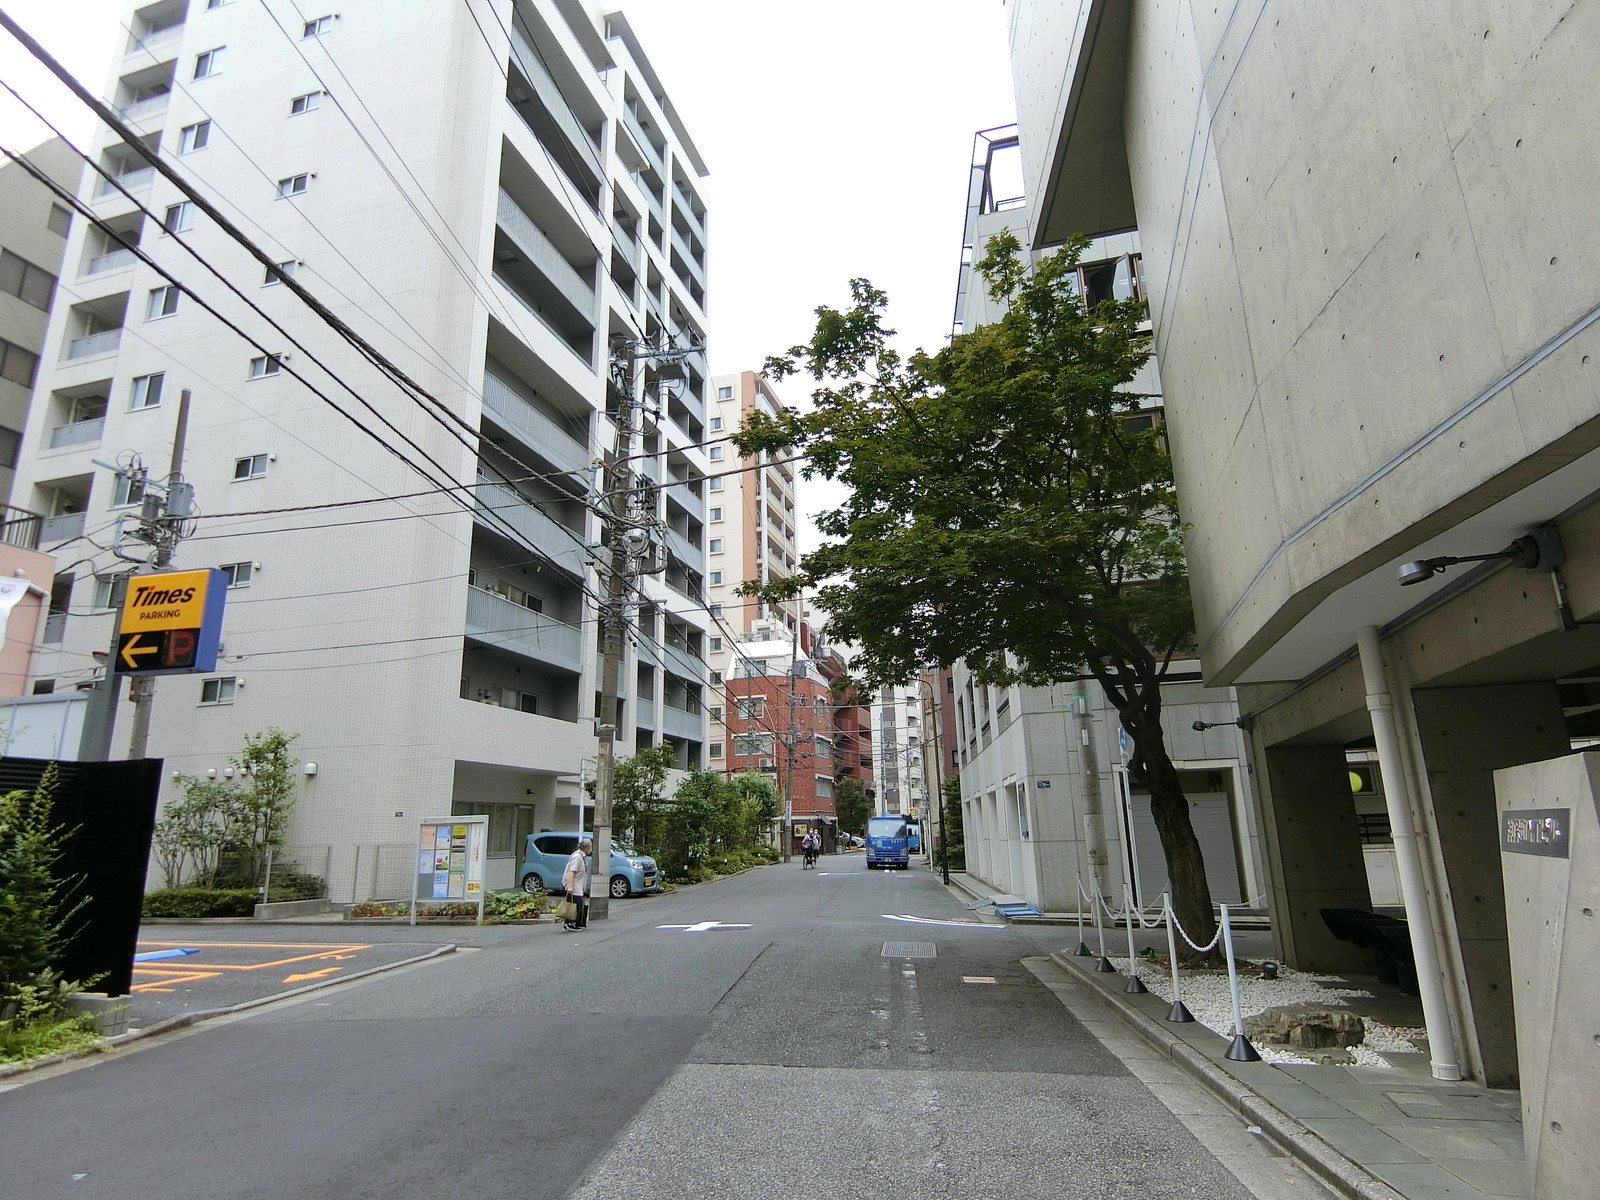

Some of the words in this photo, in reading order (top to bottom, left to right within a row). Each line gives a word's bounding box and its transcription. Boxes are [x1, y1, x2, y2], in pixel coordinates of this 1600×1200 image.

[132, 586, 196, 607] Times
[140, 609, 181, 620] PARKING
[165, 632, 194, 666] P
